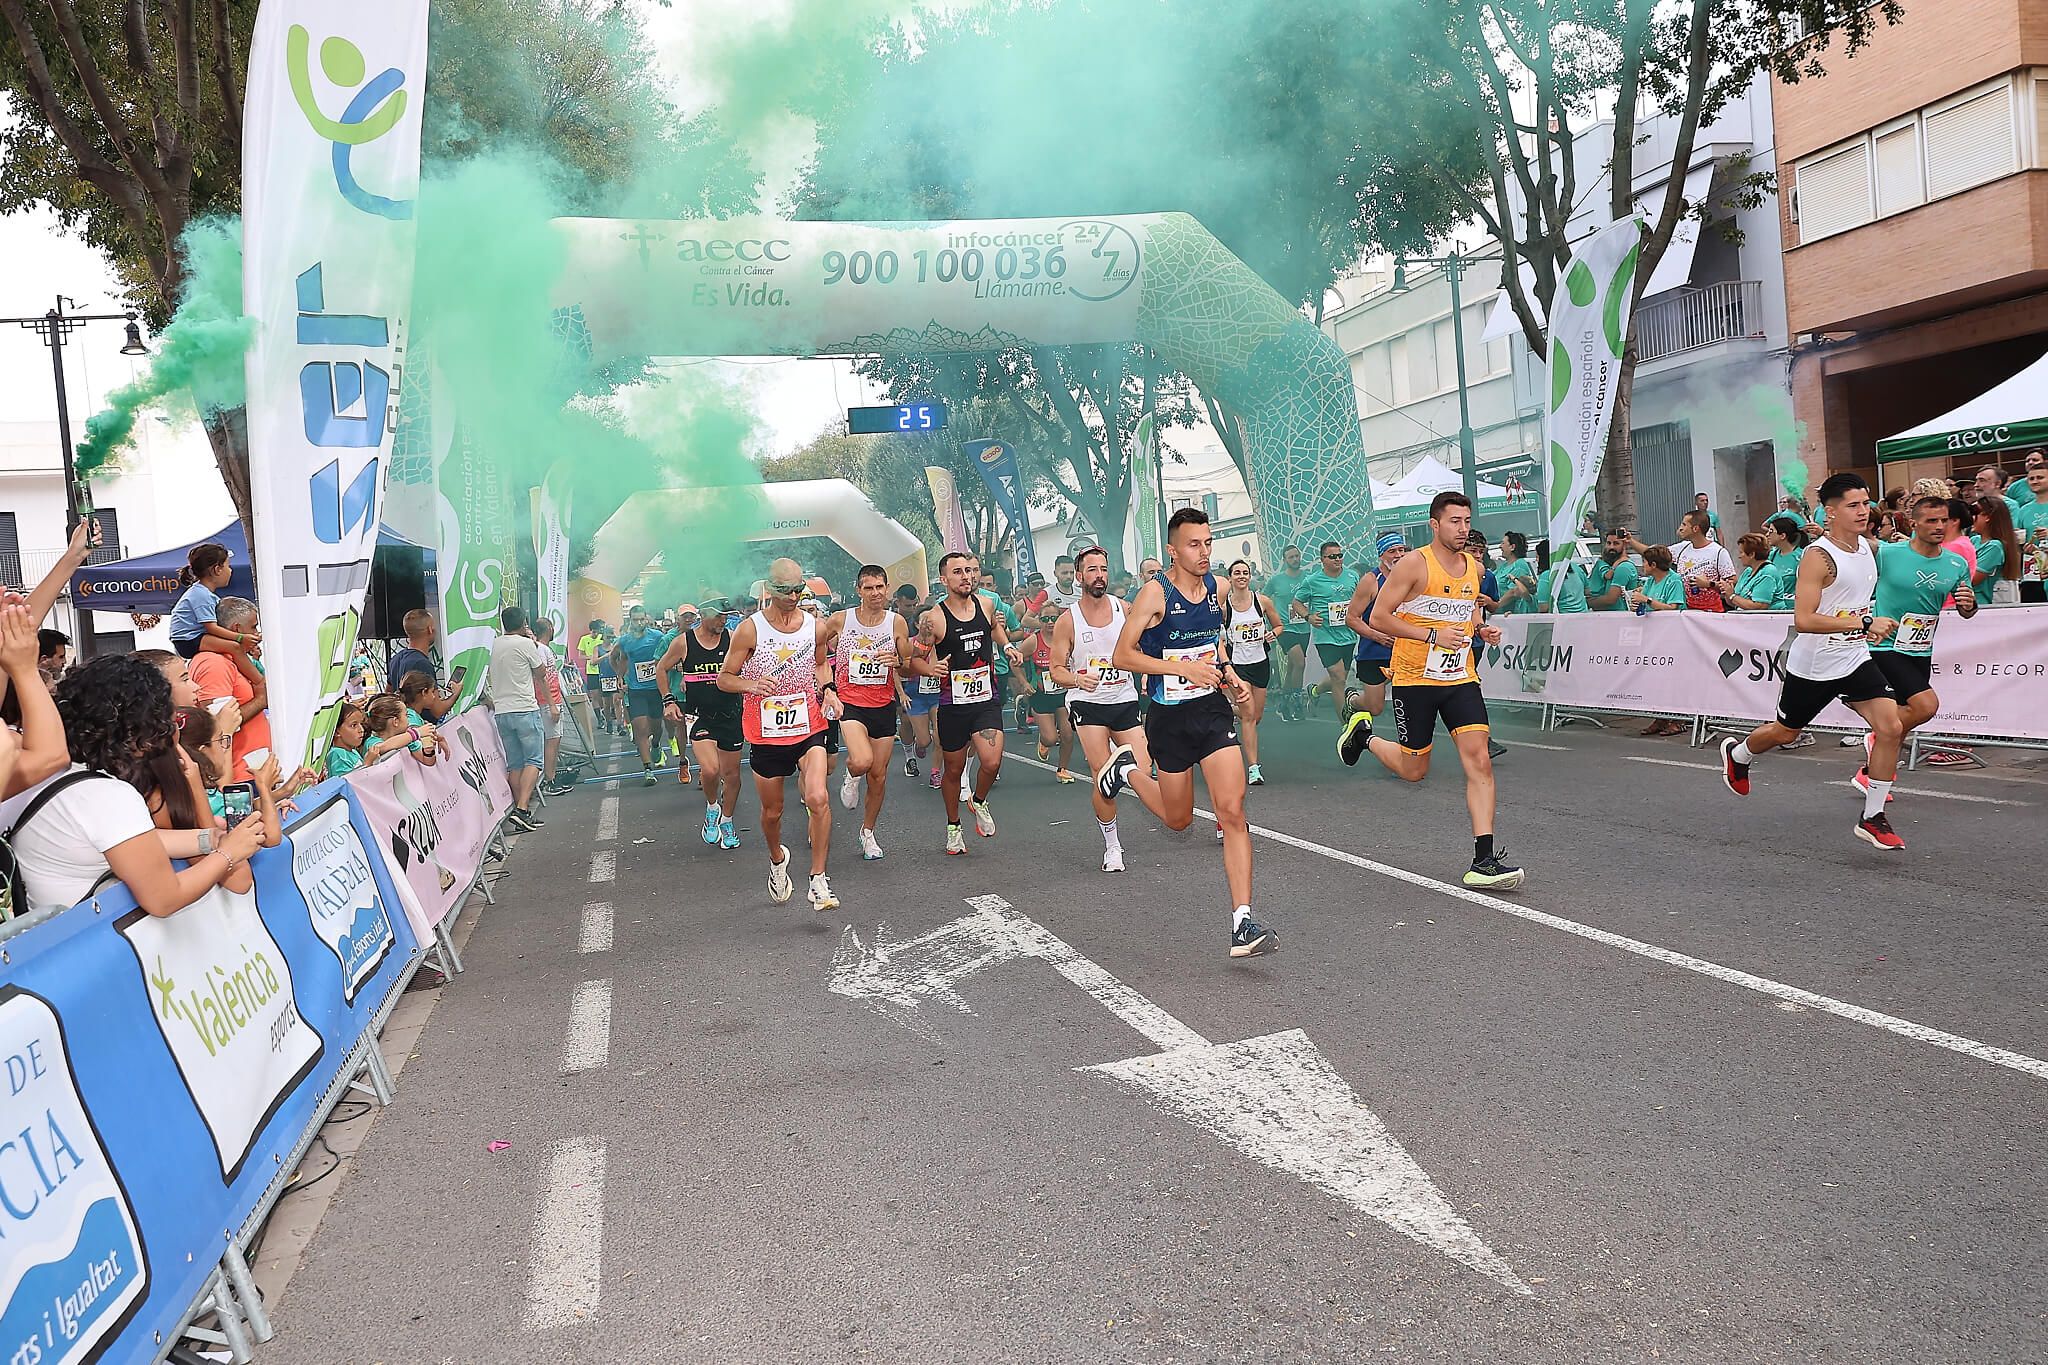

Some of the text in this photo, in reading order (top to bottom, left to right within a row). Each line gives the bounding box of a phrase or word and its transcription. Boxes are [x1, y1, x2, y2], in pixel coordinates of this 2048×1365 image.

[948, 230, 1065, 250] infocáncer
[1073, 224, 1101, 238] 24
[676, 238, 791, 262] aecc
[700, 265, 774, 276] Contra el Cáncer
[822, 245, 1067, 286] 900 100 036
[1103, 250, 1120, 278] 7
[1112, 268, 1130, 277] días
[692, 282, 791, 307] Es Vida.
[974, 278, 1066, 299] Llámame.
[1580, 330, 1598, 399] española
[1596, 359, 1608, 410] cáncer
[1947, 426, 2012, 450] aecc
[461, 450, 473, 545] asociación
[486, 452, 501, 524] Valenci
[759, 519, 811, 530] APUCCINI
[92, 575, 181, 597] cronochip
[1242, 628, 1259, 640] 636
[1908, 627, 1930, 641] 769
[858, 662, 881, 675] 693
[1439, 652, 1461, 669] 750
[1503, 645, 1573, 673] SKLUM
[1588, 655, 1674, 667] HOME & DECOR
[1976, 664, 2046, 677] DECOR
[1098, 666, 1120, 682] 733
[963, 680, 983, 694] 789
[775, 709, 797, 726] 617
[296, 827, 345, 875] DIPUTACIÓ
[180, 943, 280, 1057] València
[270, 1000, 296, 1052] esports
[4, 1039, 48, 1097] DE
[0, 1108, 84, 1222] CIA
[43, 1311, 55, 1349] i
[55, 1248, 123, 1341] Igualtat
